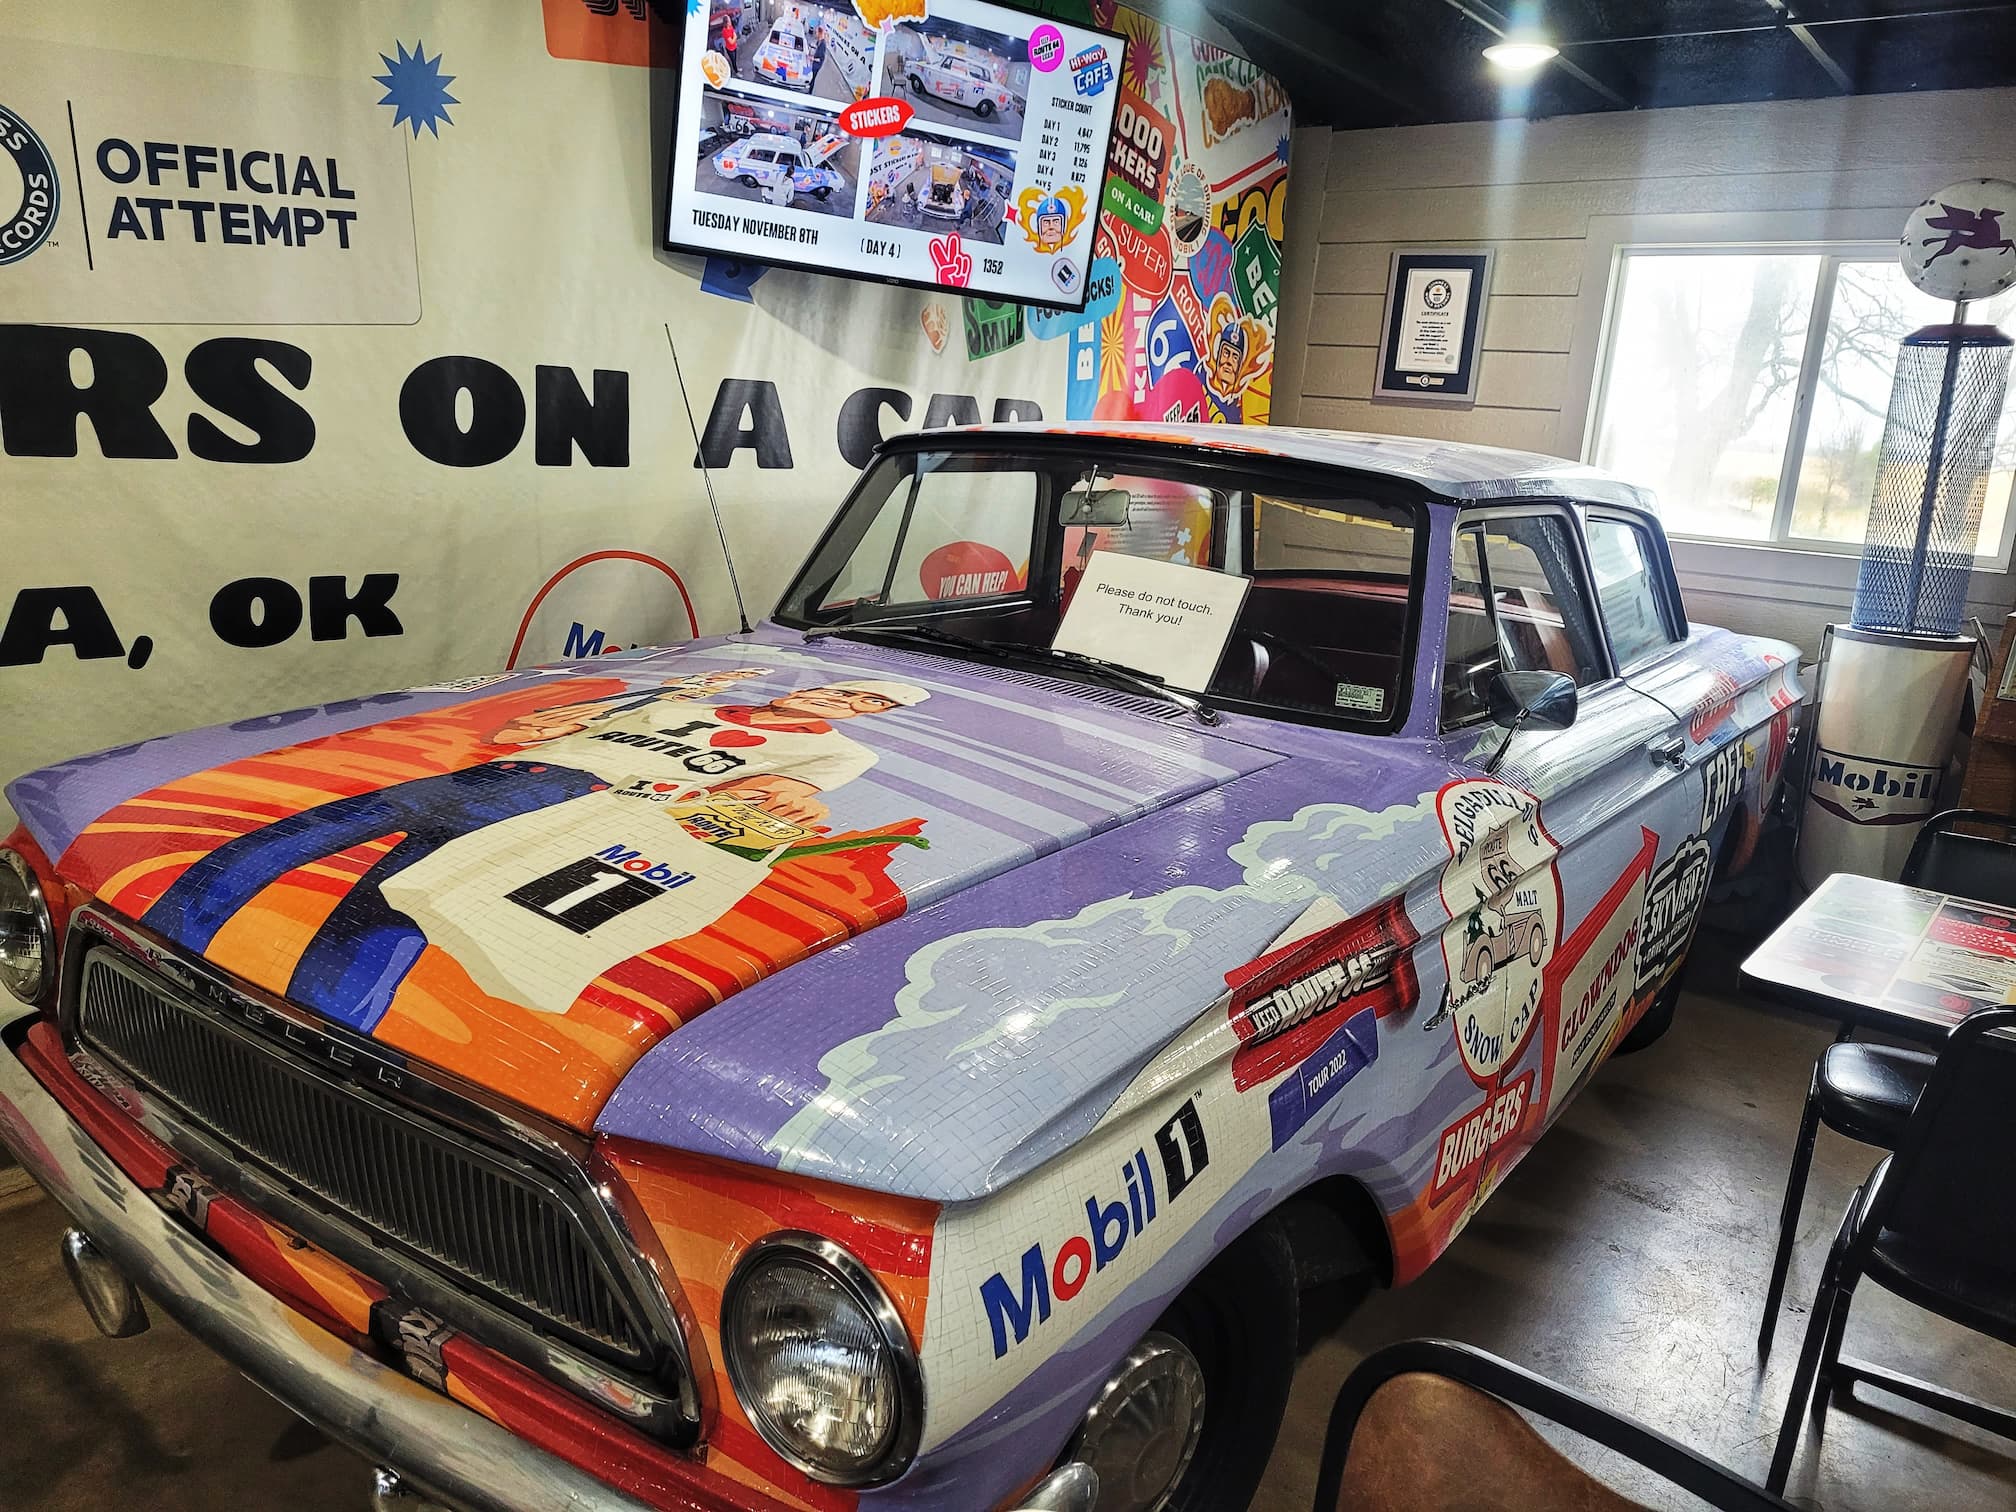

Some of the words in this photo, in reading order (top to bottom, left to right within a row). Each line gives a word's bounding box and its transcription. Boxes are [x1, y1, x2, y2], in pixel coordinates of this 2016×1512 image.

[1076, 65, 1110, 91] CAFE
[849, 104, 901, 131] STICKERS
[1051, 97, 1074, 111] STICKER
[1075, 102, 1093, 115] COUNT
[1041, 134, 1054, 146] DAY
[1044, 119, 1056, 131] DAY
[97, 138, 356, 200] OFFICIAL
[1036, 164, 1049, 175] DAY
[1039, 149, 1051, 160] DAY
[1110, 136, 1157, 189] KERS
[0, 173, 48, 254] CORDS
[107, 196, 358, 250] ATTEMPT
[1111, 187, 1126, 205] ON
[1126, 199, 1134, 212] A
[1133, 205, 1156, 225] CAR!
[692, 209, 740, 235] TUESDAY
[743, 217, 797, 242] NOVEMBER
[799, 228, 819, 245] 8TH
[983, 257, 1004, 275] 1352
[1118, 223, 1167, 281] SUPER!
[1176, 284, 1205, 348] ROUTE
[399, 355, 630, 468] ON
[694, 378, 793, 469] A
[939, 575, 957, 599] YOU
[956, 573, 981, 595] CAN
[982, 570, 1009, 593] HELP!
[1096, 583, 1135, 599] Please
[1138, 591, 1152, 602] do
[1155, 596, 1175, 607] not
[1178, 599, 1213, 615] touch.
[209, 573, 403, 648] OK
[1119, 603, 1154, 619] Thank
[1155, 612, 1183, 626] you!
[657, 720, 722, 738] I
[587, 731, 704, 758] ROUTE
[688, 752, 738, 773] 66
[613, 789, 652, 799] ROUTE
[629, 780, 652, 791] I
[1701, 738, 1744, 835] CAFE
[1818, 757, 1933, 799] Mobil
[688, 815, 732, 838] ROUTE
[1484, 837, 1503, 856] ROUTE
[595, 844, 696, 889] Mobil
[1487, 859, 1518, 894] 66
[542, 870, 630, 915] 1
[1515, 889, 1538, 907] MALT
[146, 947, 403, 1089] RAMBLER
[1464, 1013, 1504, 1064] SNOW
[1510, 978, 1538, 1044] CAP
[1308, 1069, 1330, 1097] TOUR
[1329, 1049, 1348, 1081] 2022
[1435, 1081, 1526, 1190] BURGERS
[979, 1147, 1157, 1360] Mobil
